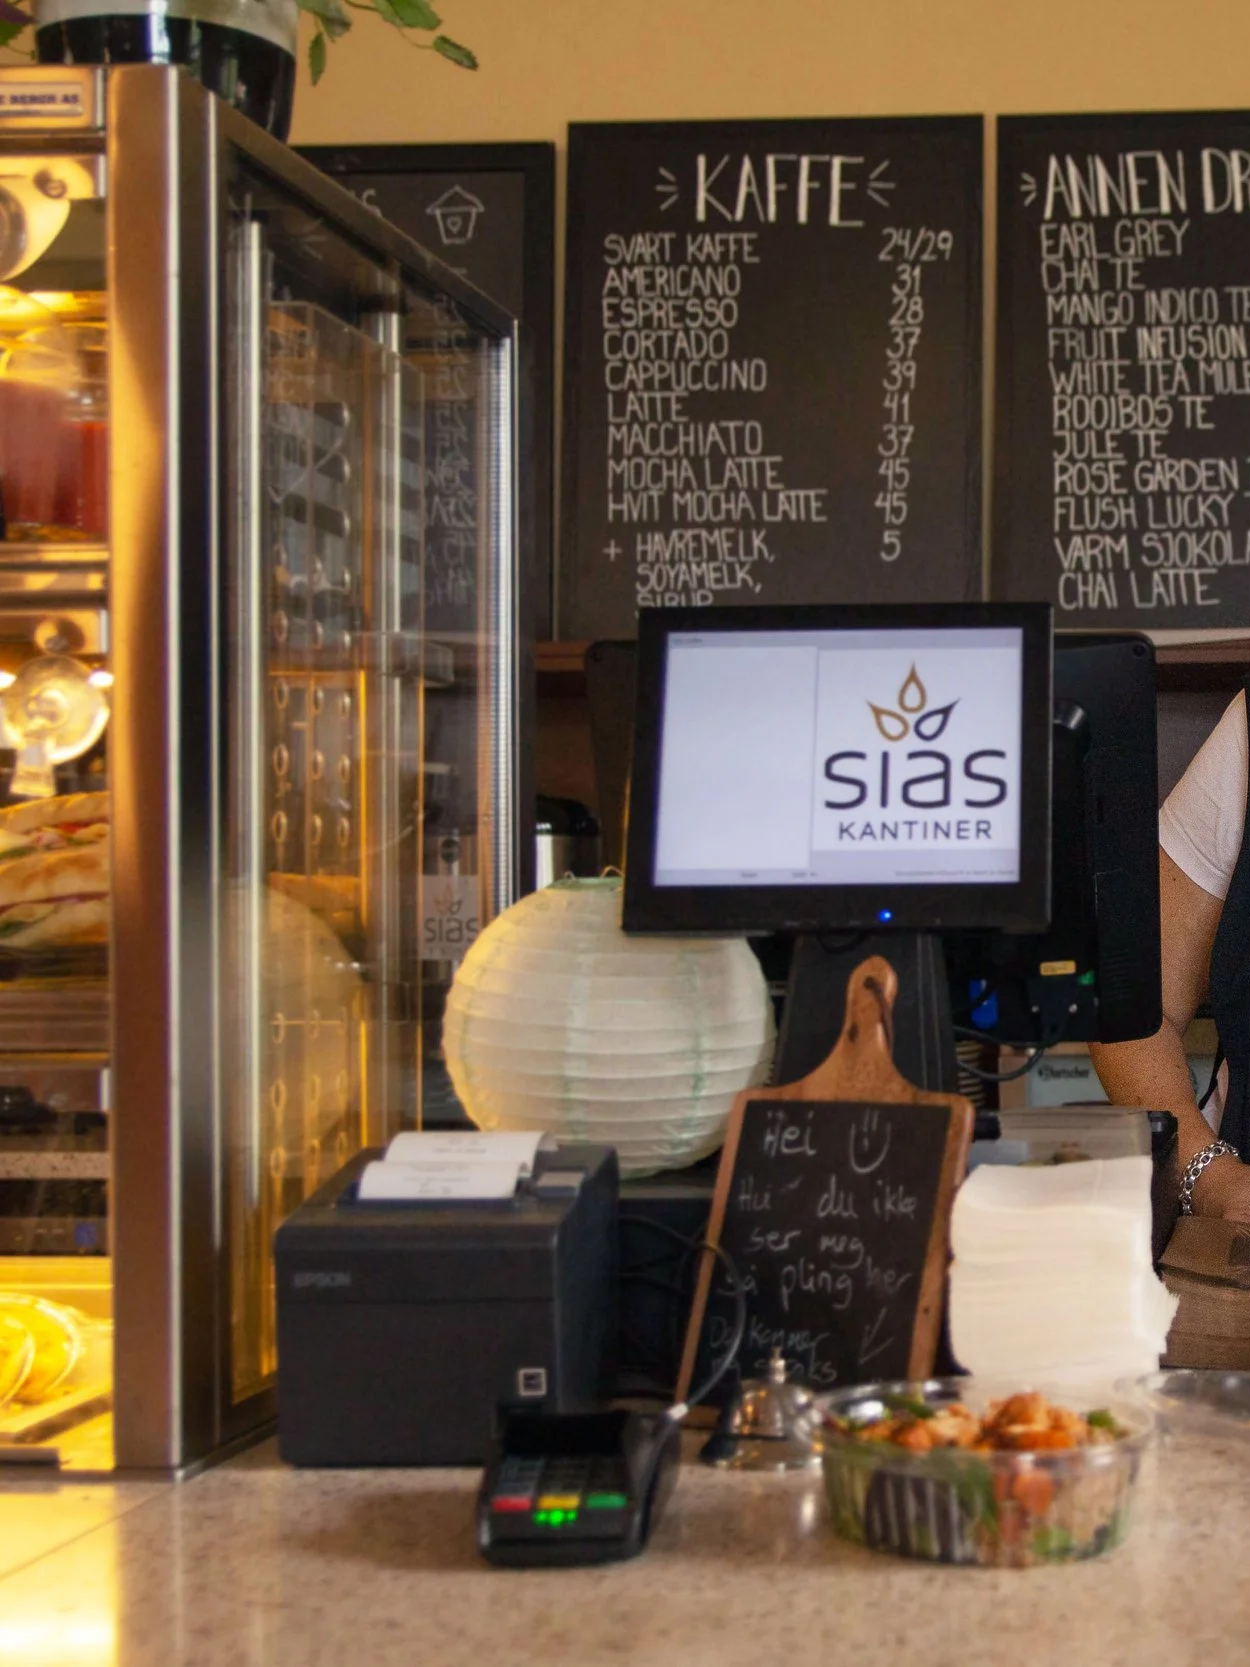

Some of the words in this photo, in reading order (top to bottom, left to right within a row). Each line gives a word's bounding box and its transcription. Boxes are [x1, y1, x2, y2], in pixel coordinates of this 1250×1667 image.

[696, 154, 865, 227] KAFFE
[1044, 149, 1188, 220] ANNEN
[604, 232, 677, 264] SVART
[687, 232, 760, 263] KAFFE
[878, 226, 953, 262] 24/29
[1040, 221, 1111, 260] EARL
[1113, 218, 1190, 258] GREY
[602, 264, 741, 298] AMERICANO
[891, 264, 922, 296] 31
[1040, 258, 1100, 293] CHAI
[1109, 258, 1146, 291] TE
[602, 299, 738, 329] ESPRESSO
[888, 296, 924, 327] 28
[1046, 293, 1134, 327] MANGO
[1144, 288, 1219, 325] INDICO
[603, 329, 729, 361] CORTADO
[885, 327, 921, 360] 37
[1047, 326, 1127, 360] FRUIT
[1136, 323, 1248, 360] INFUSION
[604, 358, 767, 392] CAPPUCCINO
[882, 361, 917, 391] 39
[1048, 359, 1131, 395] WHITE
[1143, 359, 1192, 394] TEA
[607, 391, 689, 424] LATTE
[883, 392, 909, 423] 41
[1052, 395, 1174, 431] ROOIBOS
[1178, 395, 1215, 430] TE
[607, 420, 763, 457] MACCHIATO
[877, 425, 915, 457] 37
[1052, 430, 1124, 462] JULE
[1131, 429, 1168, 460] TE
[607, 457, 698, 491] MOCHA
[705, 456, 785, 491] LATTE
[878, 457, 910, 490] 45
[1054, 460, 1128, 495] ROSE
[1133, 457, 1239, 495] GARDEN
[607, 490, 664, 523] HVIT
[673, 491, 756, 522] MOCHA
[762, 488, 828, 522] LATTE
[874, 492, 908, 525] 45
[1054, 496, 1138, 533] FLUSH
[1147, 493, 1234, 530] LUCKY
[635, 528, 776, 563] HAVREMELK,
[879, 530, 902, 562] 5
[1054, 535, 1130, 572] VARM
[635, 561, 762, 594] SOYAMELK,
[1058, 572, 1118, 611] CHAI
[1131, 568, 1220, 609] LATTE
[824, 750, 1008, 810] sias
[839, 820, 992, 841] KANTINER
[763, 1111, 817, 1157] Hei
[817, 1174, 858, 1219] du
[744, 1228, 801, 1251] ser
[781, 1257, 852, 1311] pling
